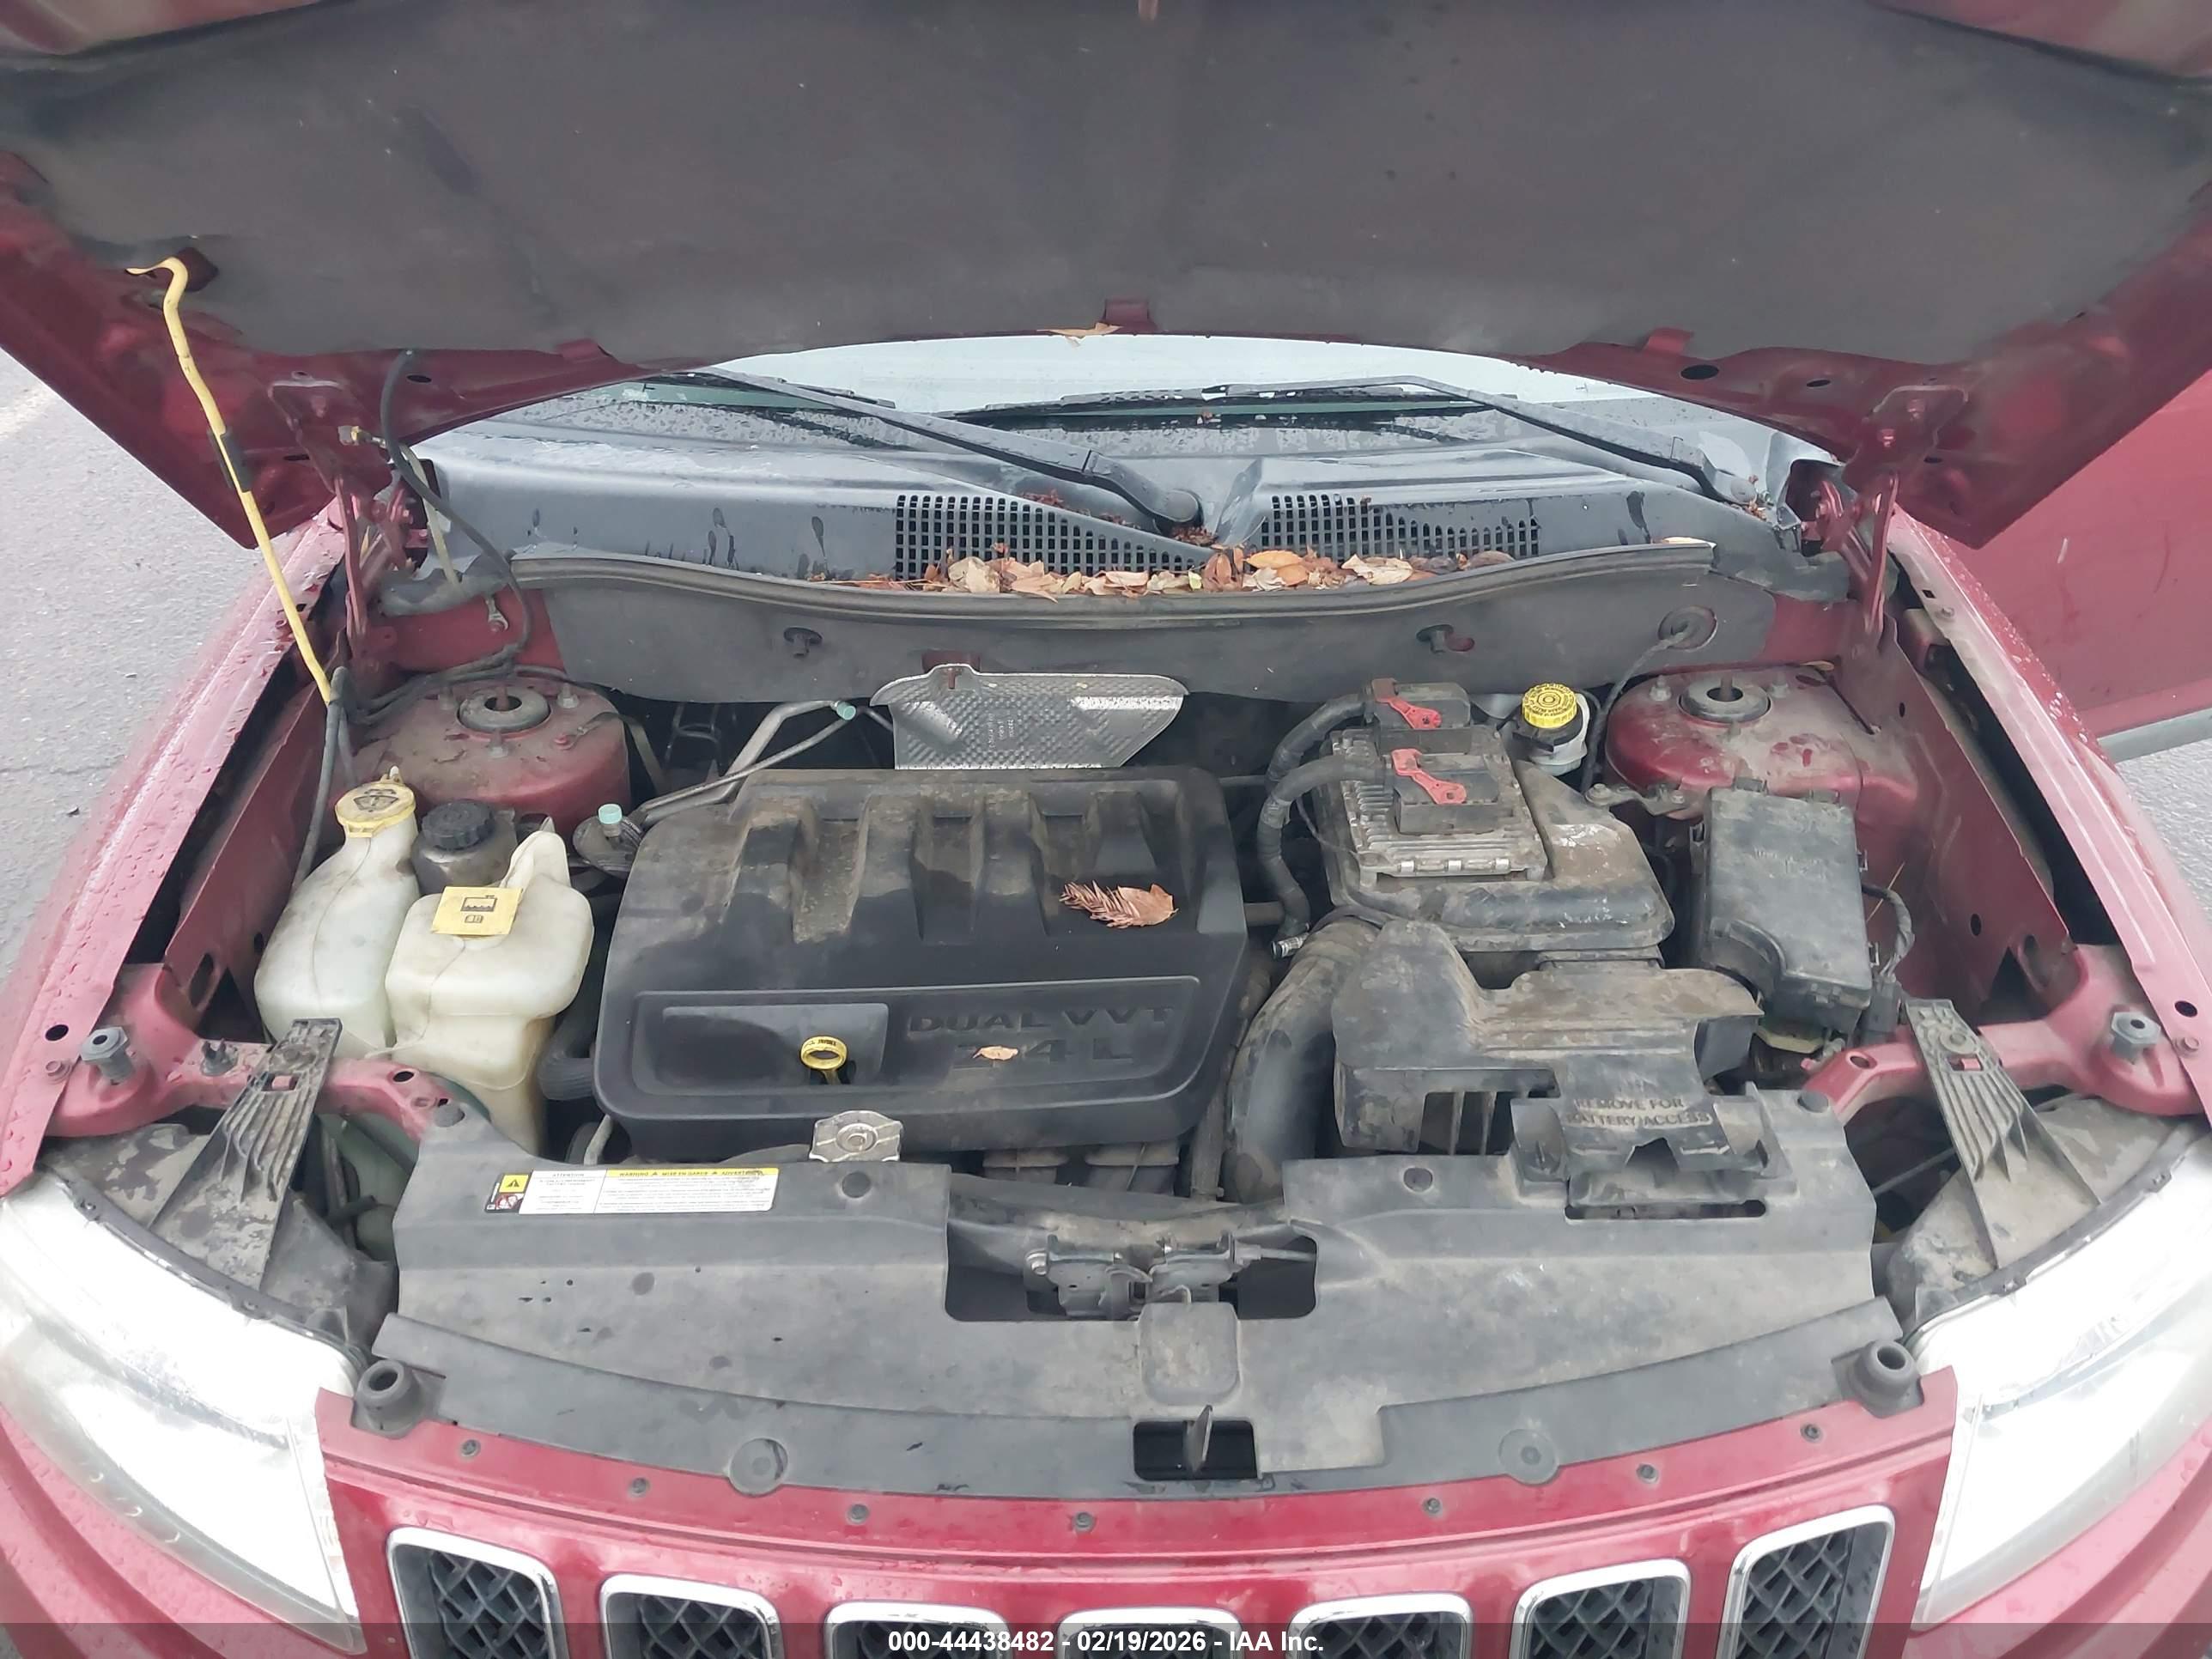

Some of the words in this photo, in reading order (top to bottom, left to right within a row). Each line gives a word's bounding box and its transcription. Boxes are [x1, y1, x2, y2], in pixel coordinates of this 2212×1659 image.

[907, 1012, 1054, 1033] DUAL
[1061, 1005, 1174, 1025] VVT
[1573, 1097, 1646, 1111] REMOVE
[1649, 1097, 1685, 1109] FOR
[1565, 1112, 1638, 1127] BATTERY
[1643, 1111, 1711, 1127] ACCESS
